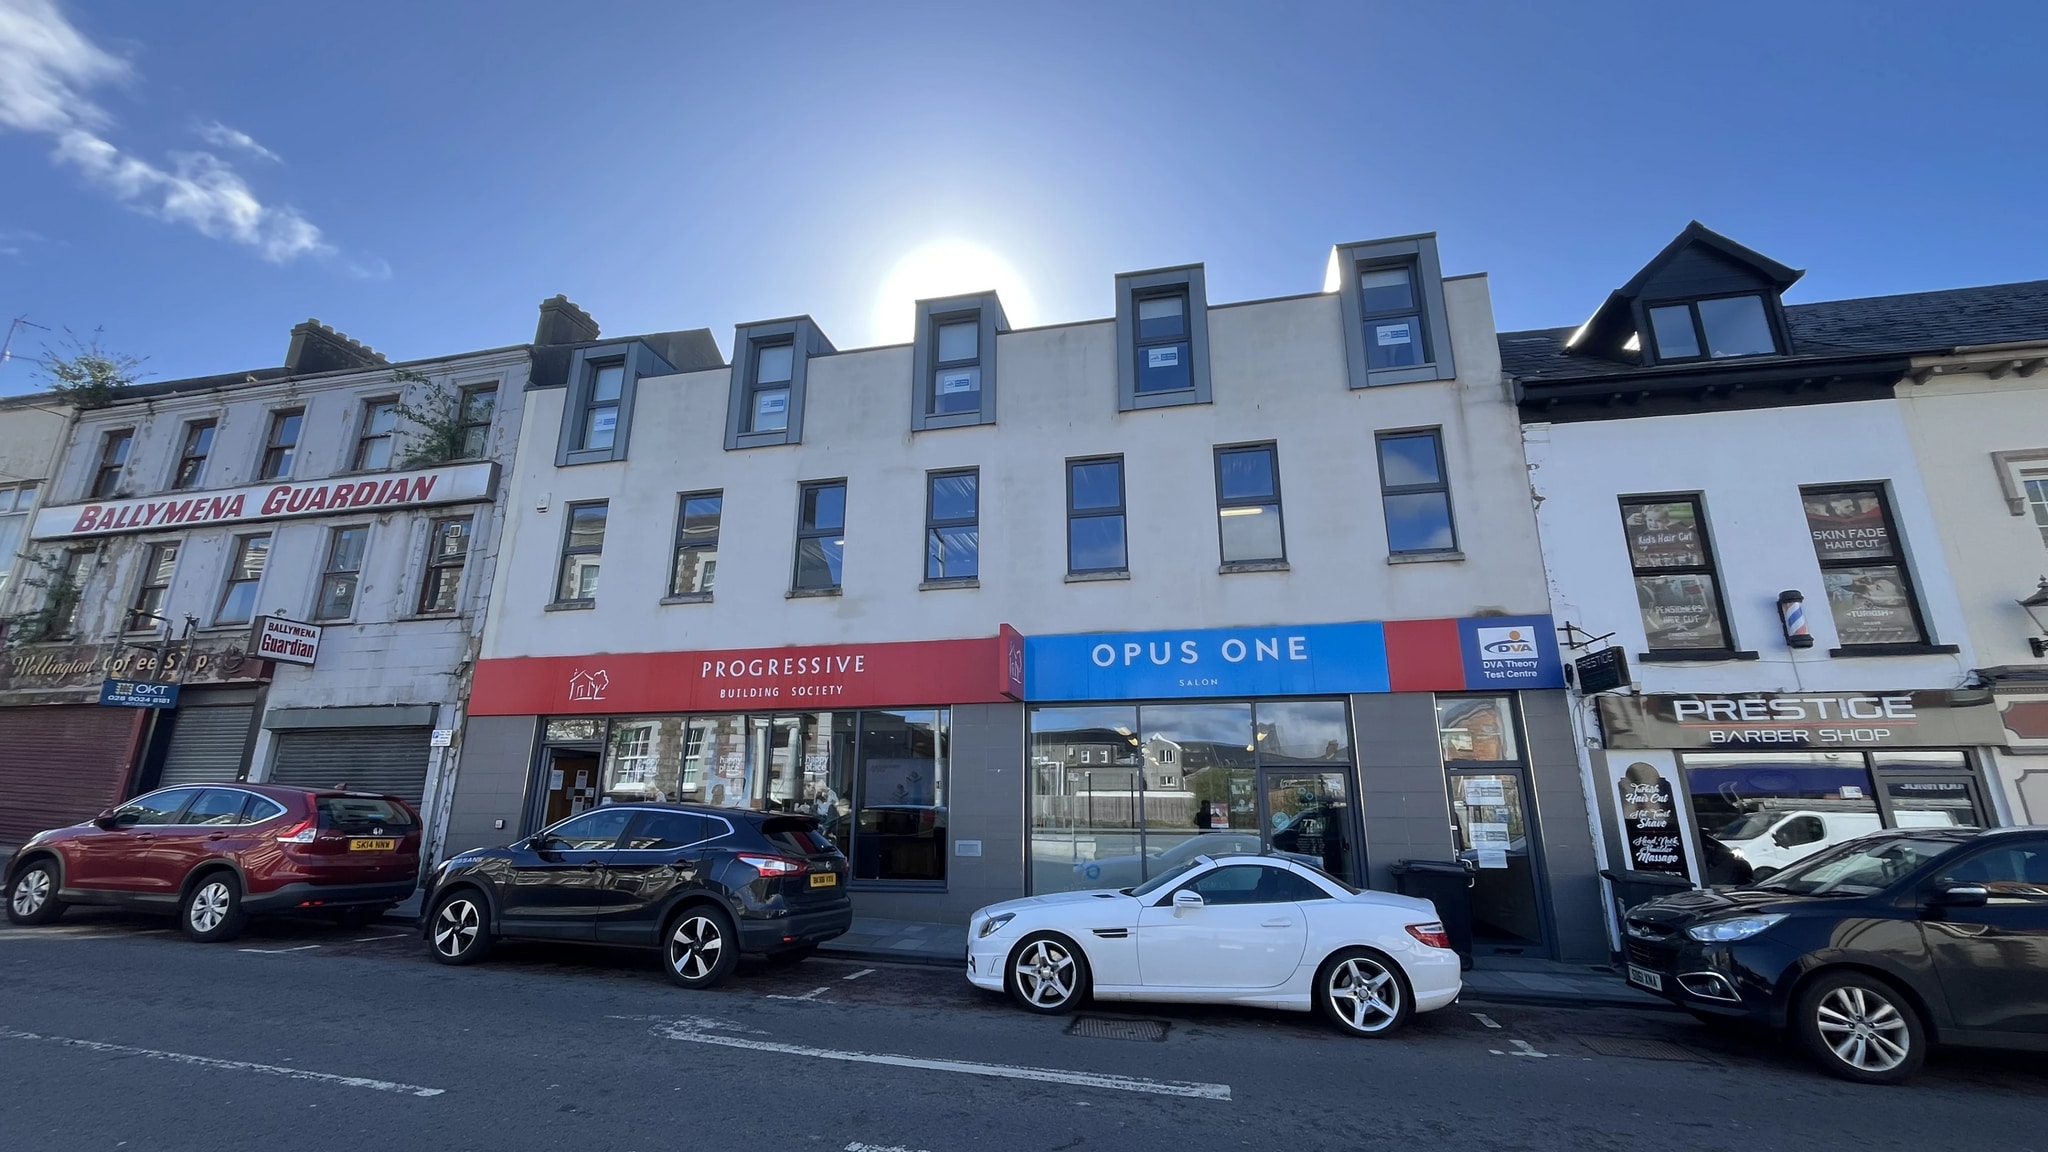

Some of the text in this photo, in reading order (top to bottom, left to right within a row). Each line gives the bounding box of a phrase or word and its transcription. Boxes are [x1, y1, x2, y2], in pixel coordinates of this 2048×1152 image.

[72, 475, 438, 533] BALLYMENA GUARDIAN
[1657, 533, 1677, 542] Hair
[1679, 531, 1692, 541] Cut
[1813, 527, 1887, 540] SKIN FADE
[1824, 539, 1879, 550] HAIR CUT
[1683, 614, 1699, 623] CUT
[268, 622, 316, 638] BALLYMENA
[261, 633, 315, 658] Guardian
[1498, 643, 1533, 653] DVA
[1092, 636, 1308, 667] OPUS ONE
[1483, 660, 1538, 669] DVA Theory
[1577, 651, 1614, 669] PRESTIGE
[12, 654, 97, 684] Wellington
[702, 655, 865, 678] PROGRESSIVE
[1484, 670, 1538, 679] Test Centre
[1179, 678, 1218, 687] SALON
[136, 684, 169, 695] OKT
[720, 685, 843, 699] BUILDING SOCIETY
[1673, 696, 1917, 721] PRESTIGE
[1709, 728, 1891, 743] BARBER SHOP
[720, 755, 742, 765] happy
[806, 753, 829, 764] happy
[719, 764, 739, 773] place
[805, 762, 827, 772] place
[1630, 783, 1660, 794] Turkish
[1626, 793, 1668, 804] Hair Cut
[1630, 809, 1648, 818] Hot
[1637, 818, 1667, 828] Shave
[356, 840, 373, 849] SK14
[1633, 836, 1658, 846] Head,
[1636, 852, 1679, 863] Massage
